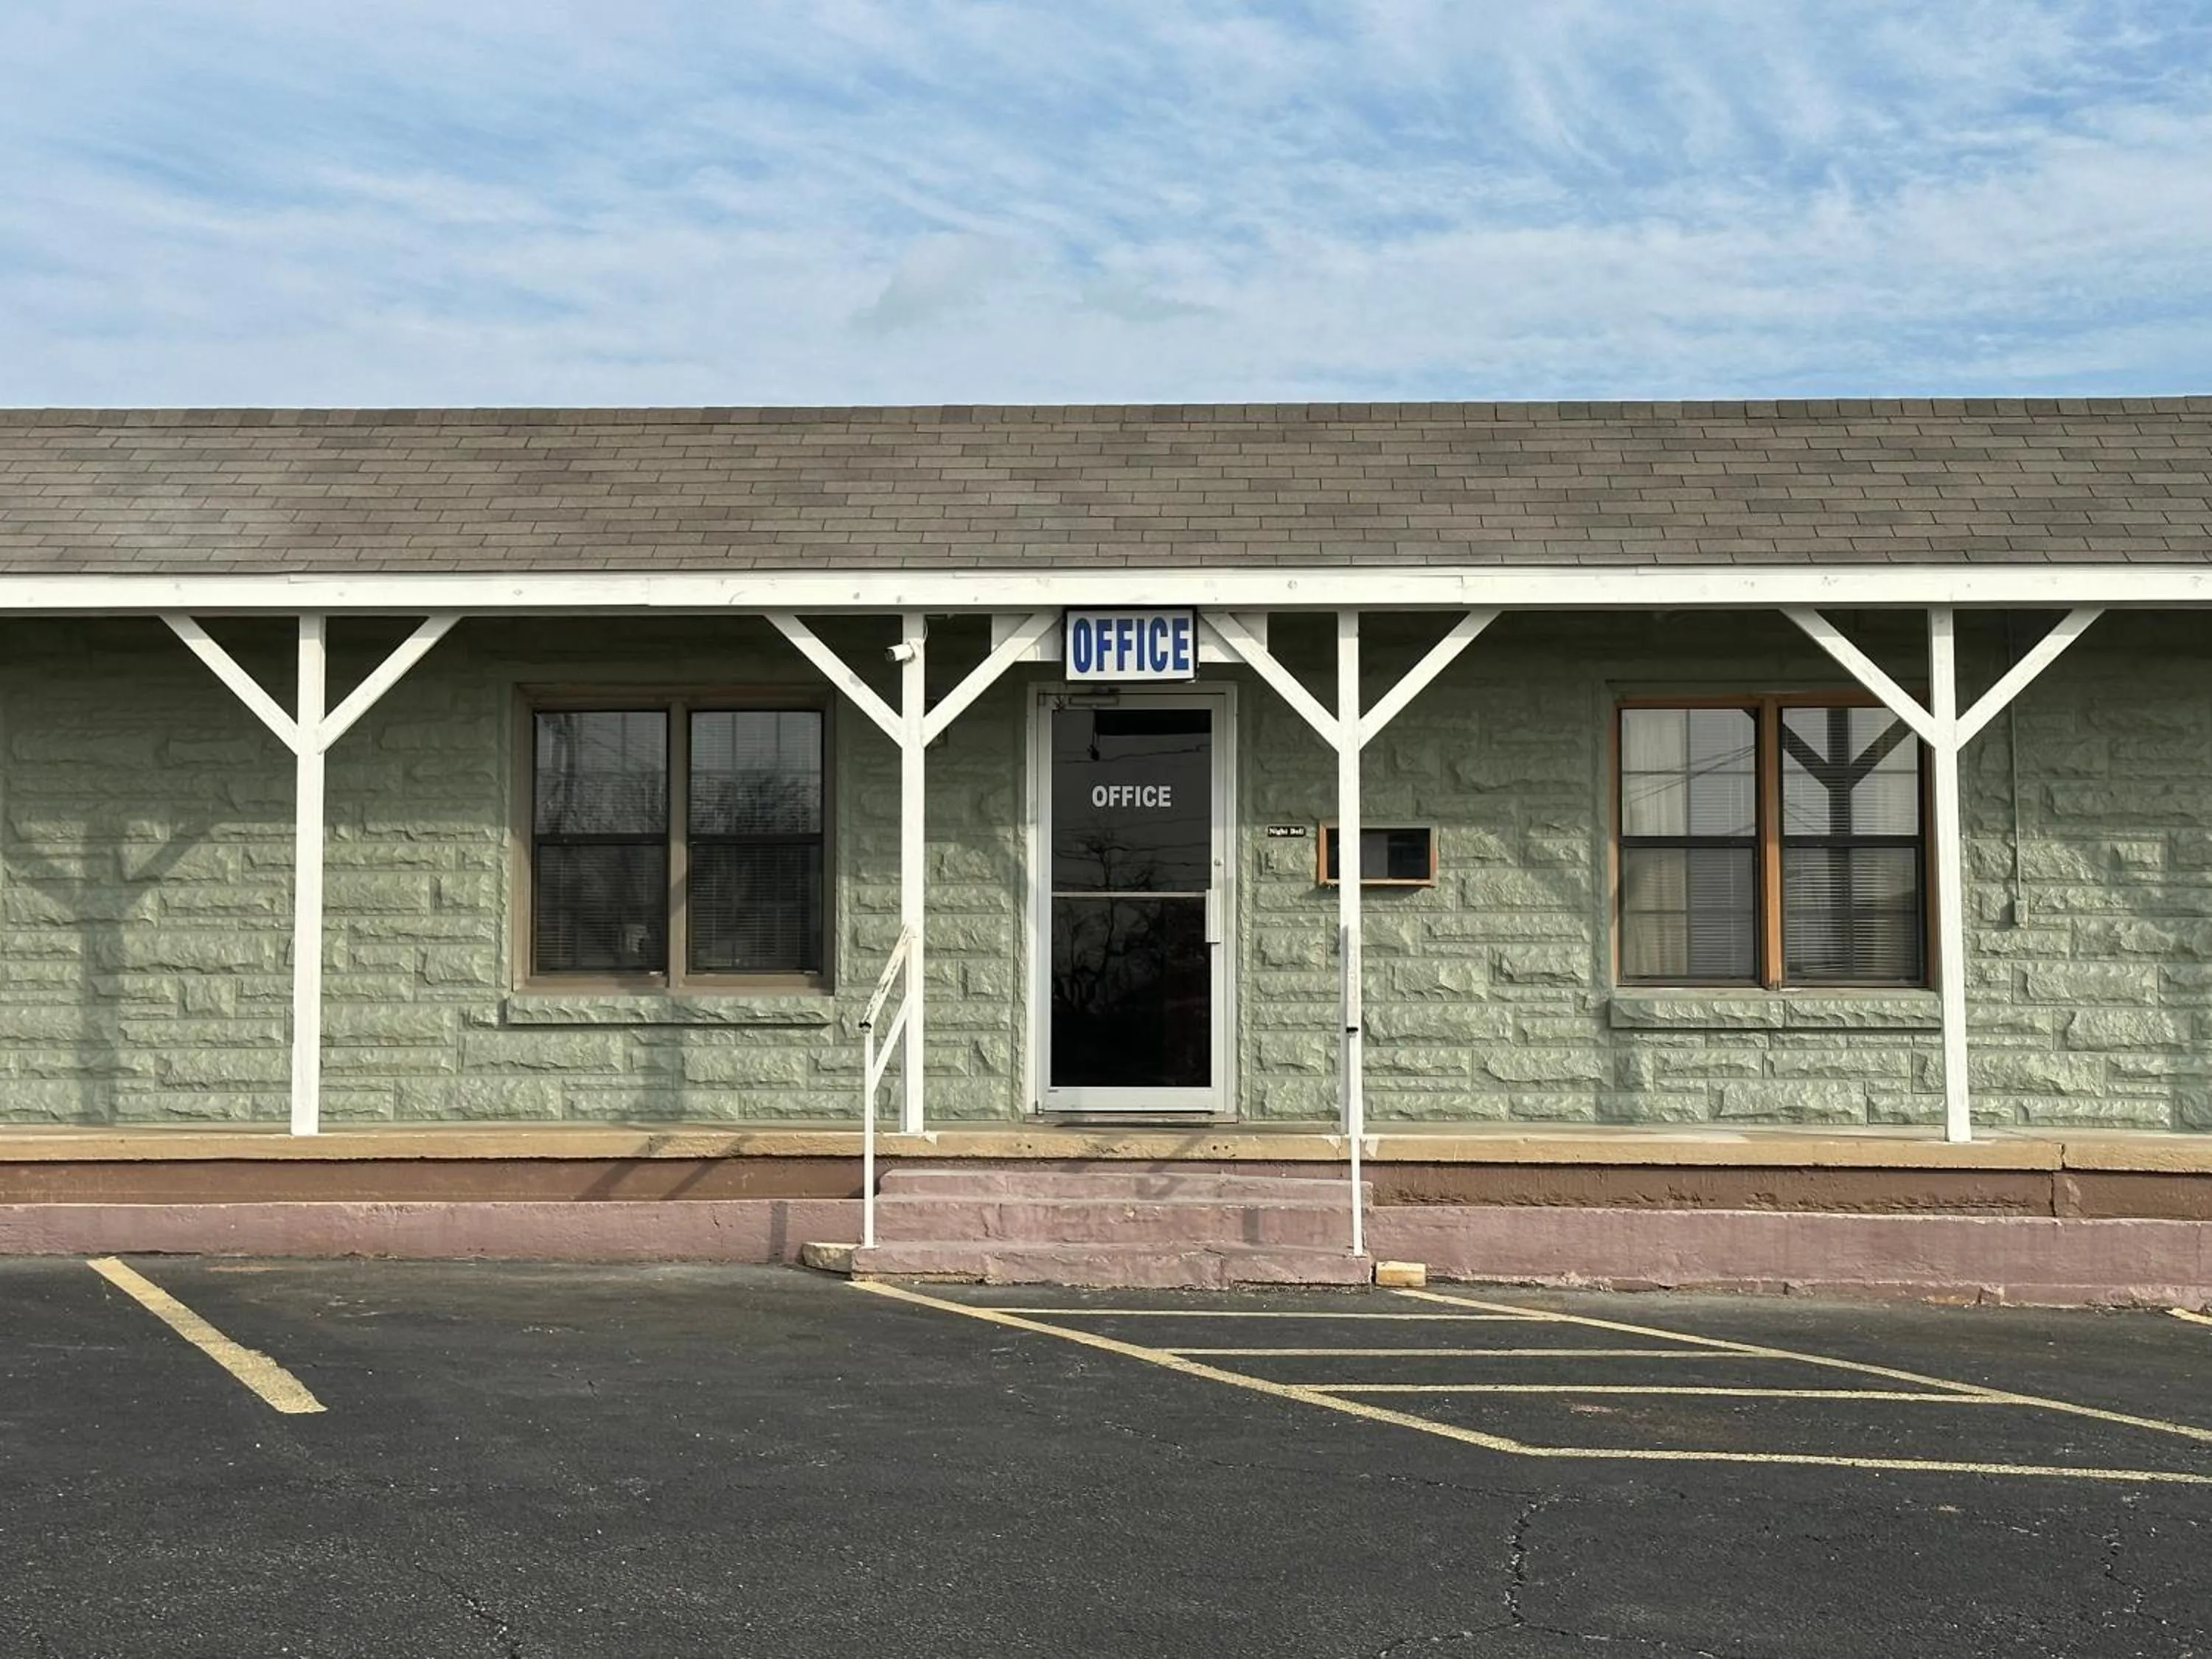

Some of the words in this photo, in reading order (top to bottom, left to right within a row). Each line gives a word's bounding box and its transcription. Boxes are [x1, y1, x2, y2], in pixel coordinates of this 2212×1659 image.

[1073, 616, 1189, 673] OFFICE
[1092, 785, 1172, 807] OFFICE
[1269, 827, 1288, 835] Night
